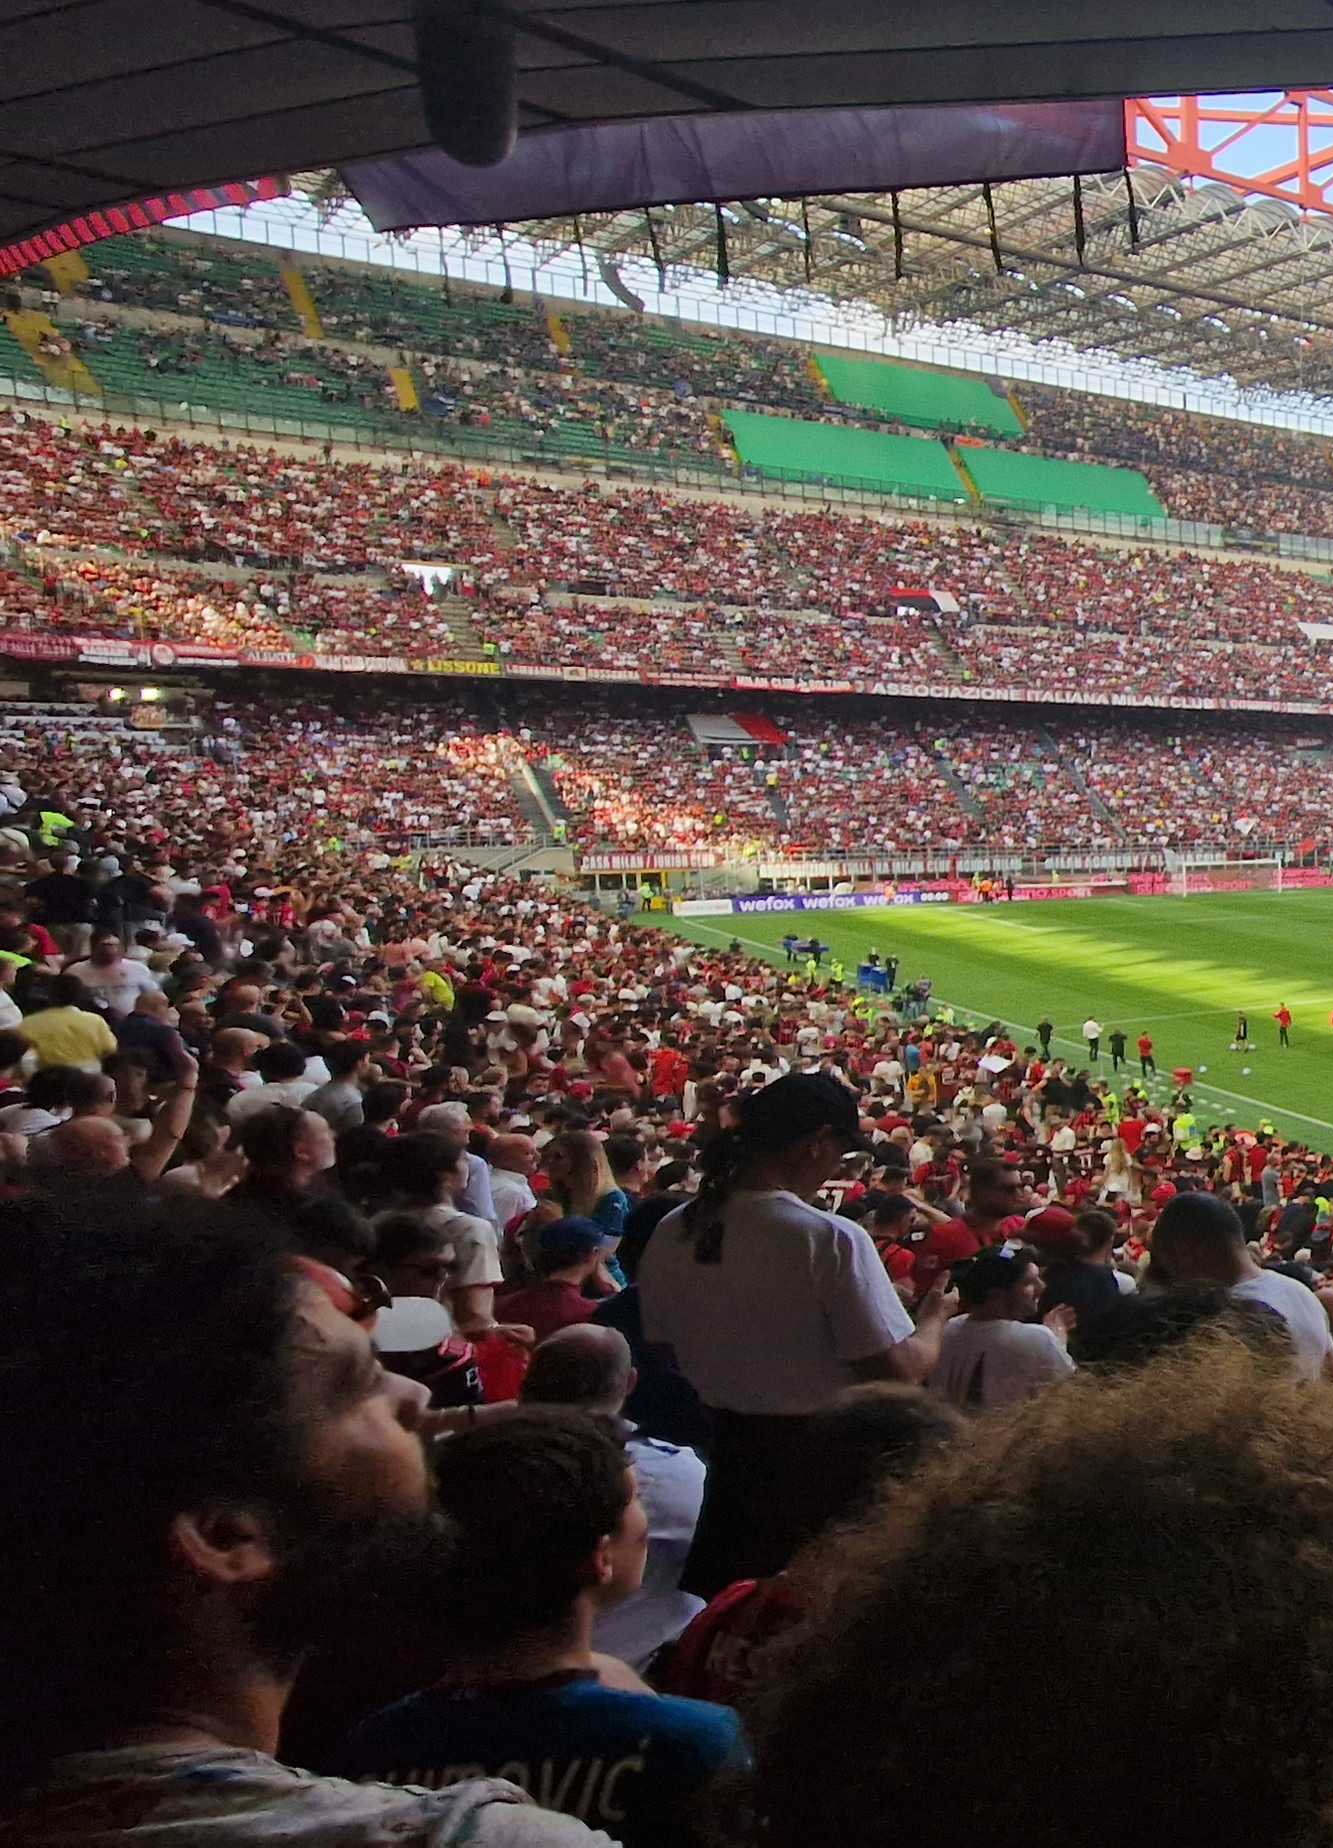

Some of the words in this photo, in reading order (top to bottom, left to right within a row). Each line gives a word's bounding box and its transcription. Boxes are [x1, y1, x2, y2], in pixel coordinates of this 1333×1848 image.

[427, 660, 500, 674] LISSONE
[872, 682, 1021, 701] ASSOCIAZIONE
[1027, 688, 1111, 705] ITALIANA
[1112, 693, 1167, 707] MILAN
[739, 895, 795, 912] wefox
[803, 893, 856, 909] wefox
[863, 892, 914, 907] weox
